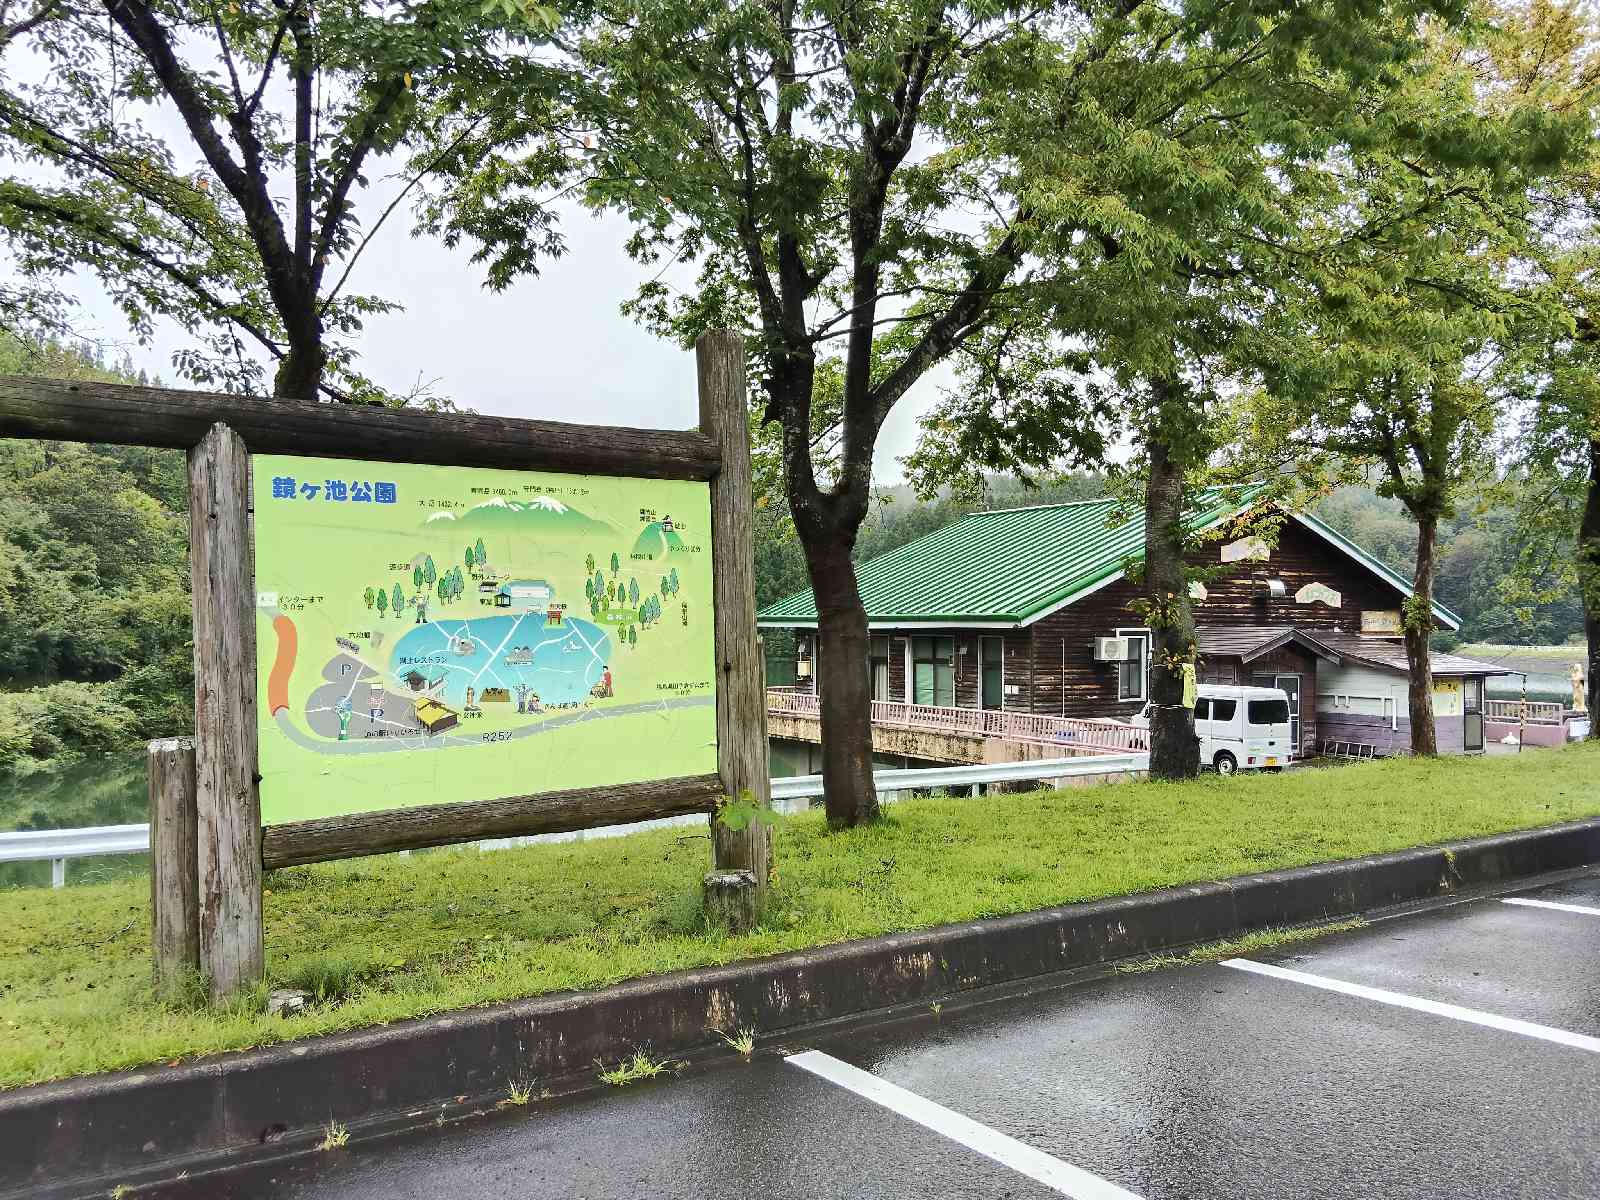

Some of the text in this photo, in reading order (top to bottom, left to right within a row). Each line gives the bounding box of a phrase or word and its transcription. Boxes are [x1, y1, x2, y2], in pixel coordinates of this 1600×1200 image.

[341, 663, 352, 676] P
[370, 708, 384, 724] P
[482, 731, 513, 743] R252
